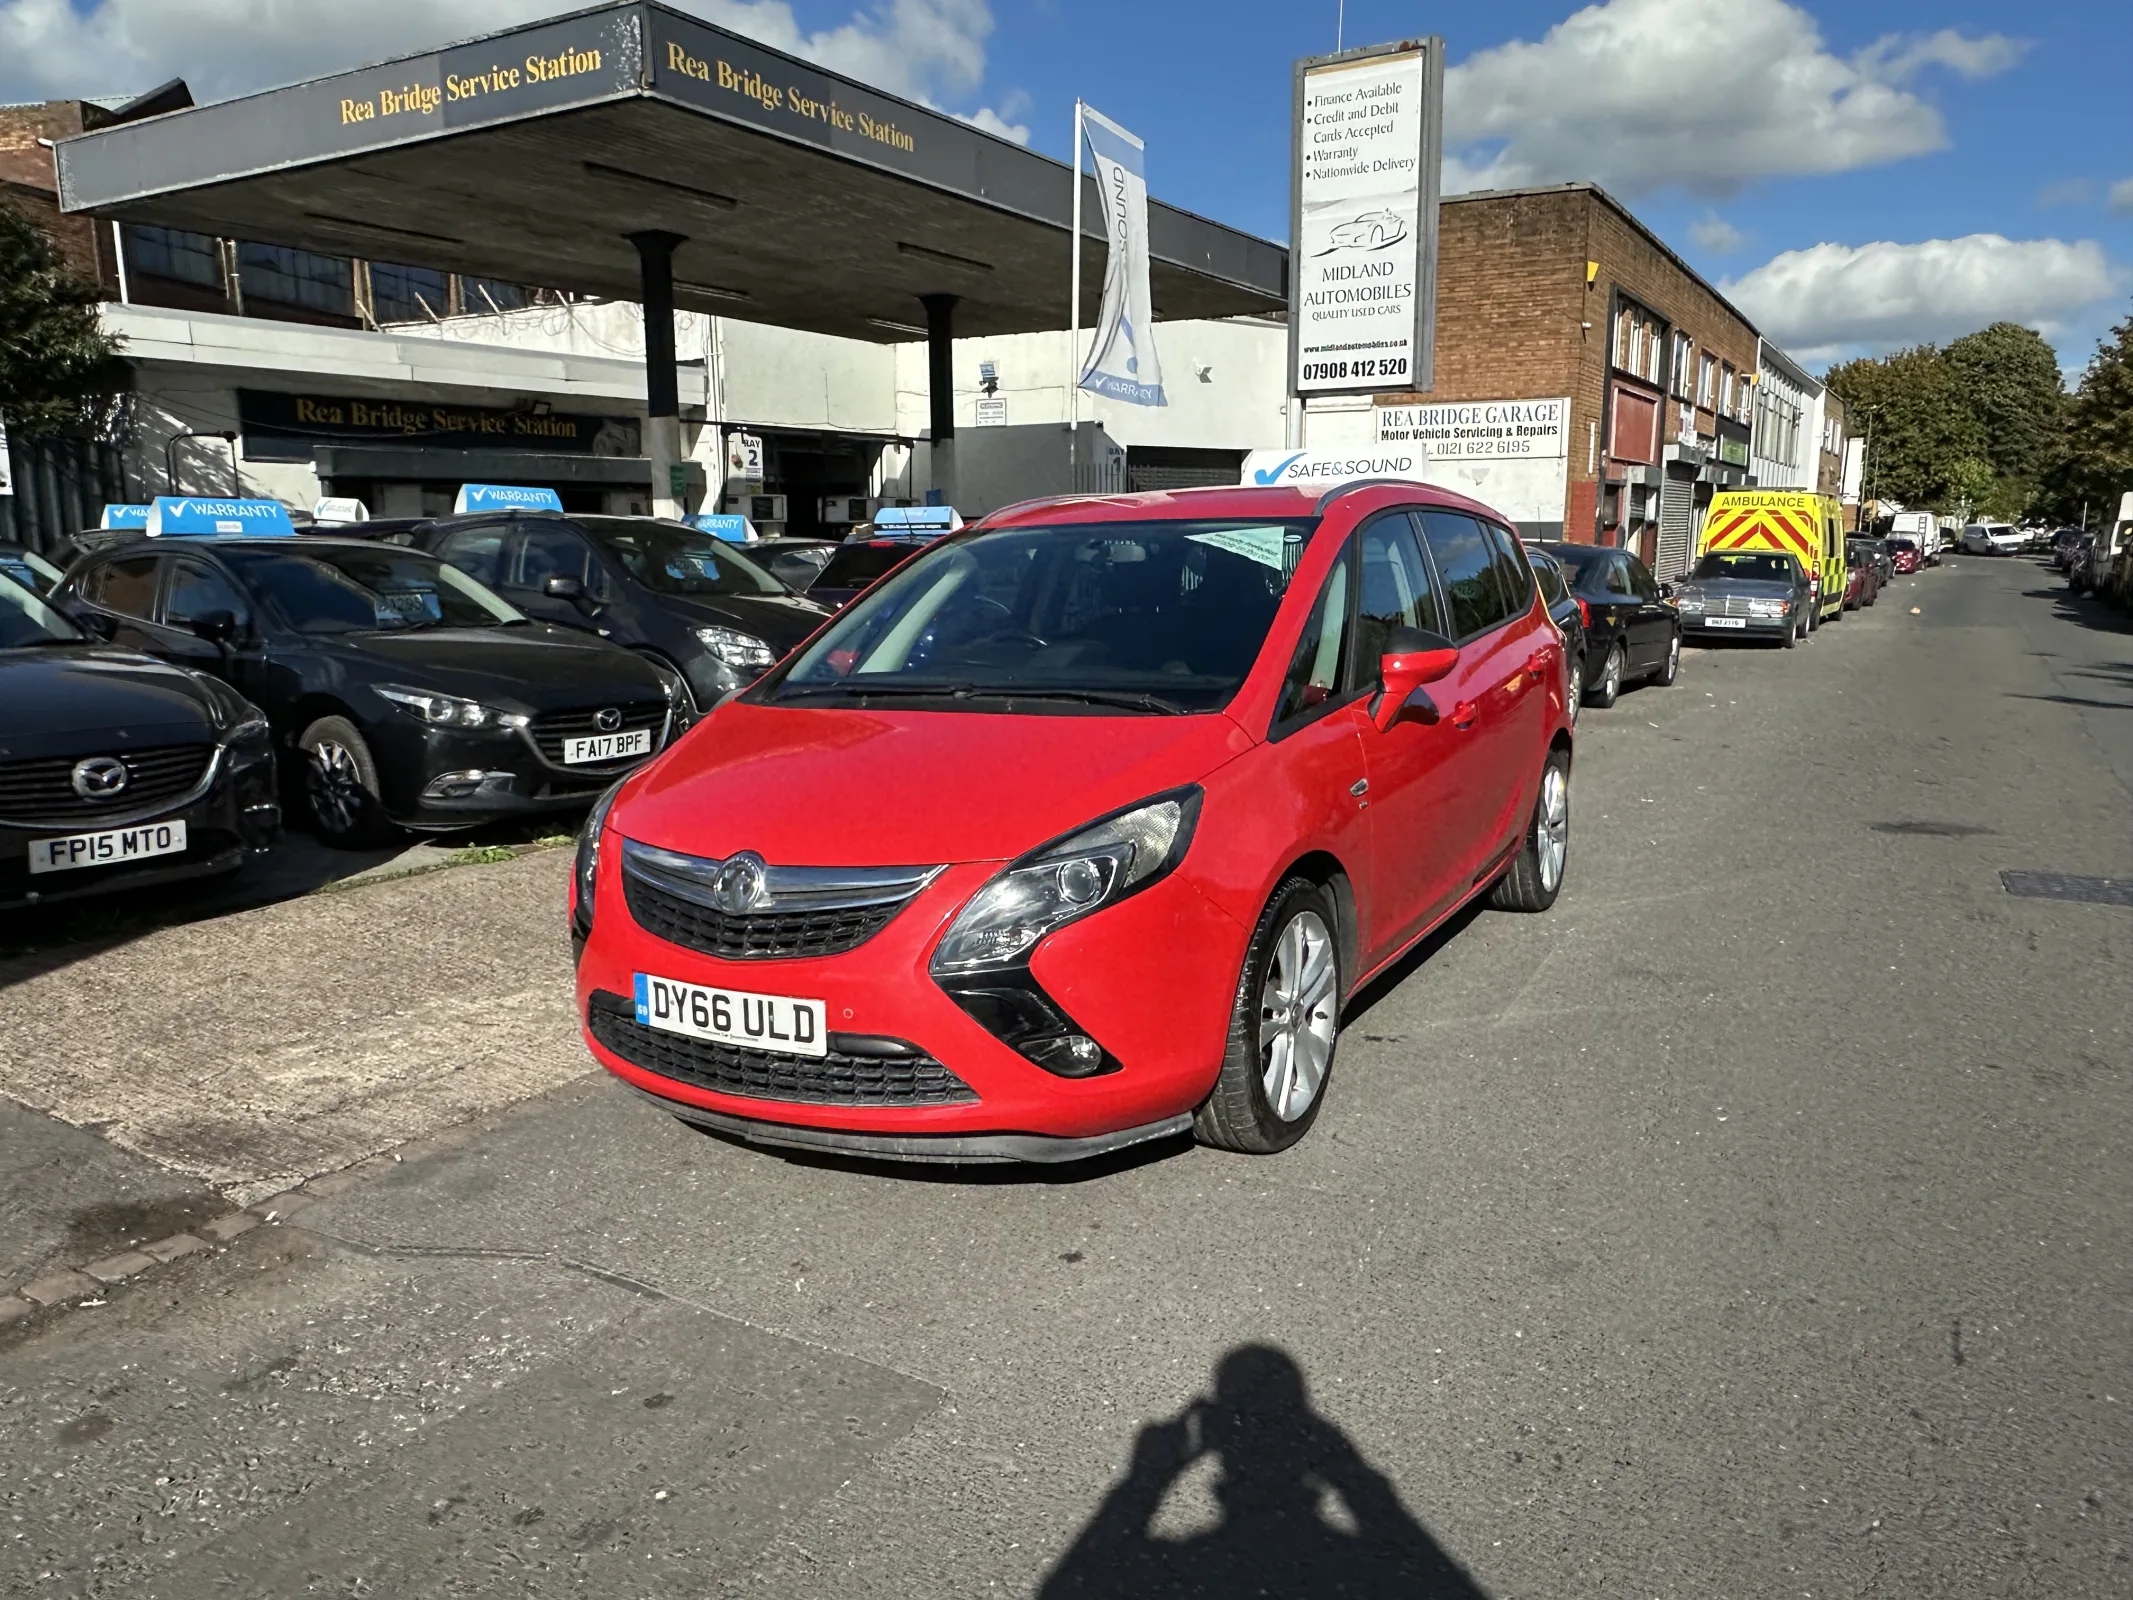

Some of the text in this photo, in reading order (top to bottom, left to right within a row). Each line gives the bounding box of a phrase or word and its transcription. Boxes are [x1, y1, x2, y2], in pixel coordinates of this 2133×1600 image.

[341, 47, 601, 124] Rea Bridge Service Station
[667, 41, 914, 152] Rea Bridge Service Station
[1314, 82, 1402, 107] Finance Available
[1314, 102, 1399, 125] Credit and Debit
[1313, 120, 1393, 143] Cards Accepted
[1313, 147, 1358, 162] Warranty
[1313, 157, 1416, 180] Nationwide Delivery
[1322, 261, 1394, 282] MIDLAND
[1304, 283, 1412, 307] AUTOMOBILES
[1312, 305, 1401, 321] QUALITY USED CARS
[1303, 358, 1407, 380] 07908 412 520
[296, 398, 577, 437] Rea Bridge Service Station
[1382, 404, 1558, 427] REA BRIDGE GARAGE
[1381, 425, 1558, 441] Motor Vehicle Servicing & Repairs
[749, 449, 758, 466] 2
[1437, 442, 1462, 455] 0121
[1467, 441, 1493, 454] 622
[1497, 440, 1530, 453] 6195
[1288, 457, 1412, 478] SAFE&SOUND
[488, 490, 552, 504] WARRANTY
[1721, 496, 1805, 508] AMBULANCE
[190, 502, 278, 518] WARRANTY
[576, 733, 643, 759] FA17 BPF
[49, 826, 171, 865] FP15 MTO
[653, 981, 815, 1044] DY66 ULD
